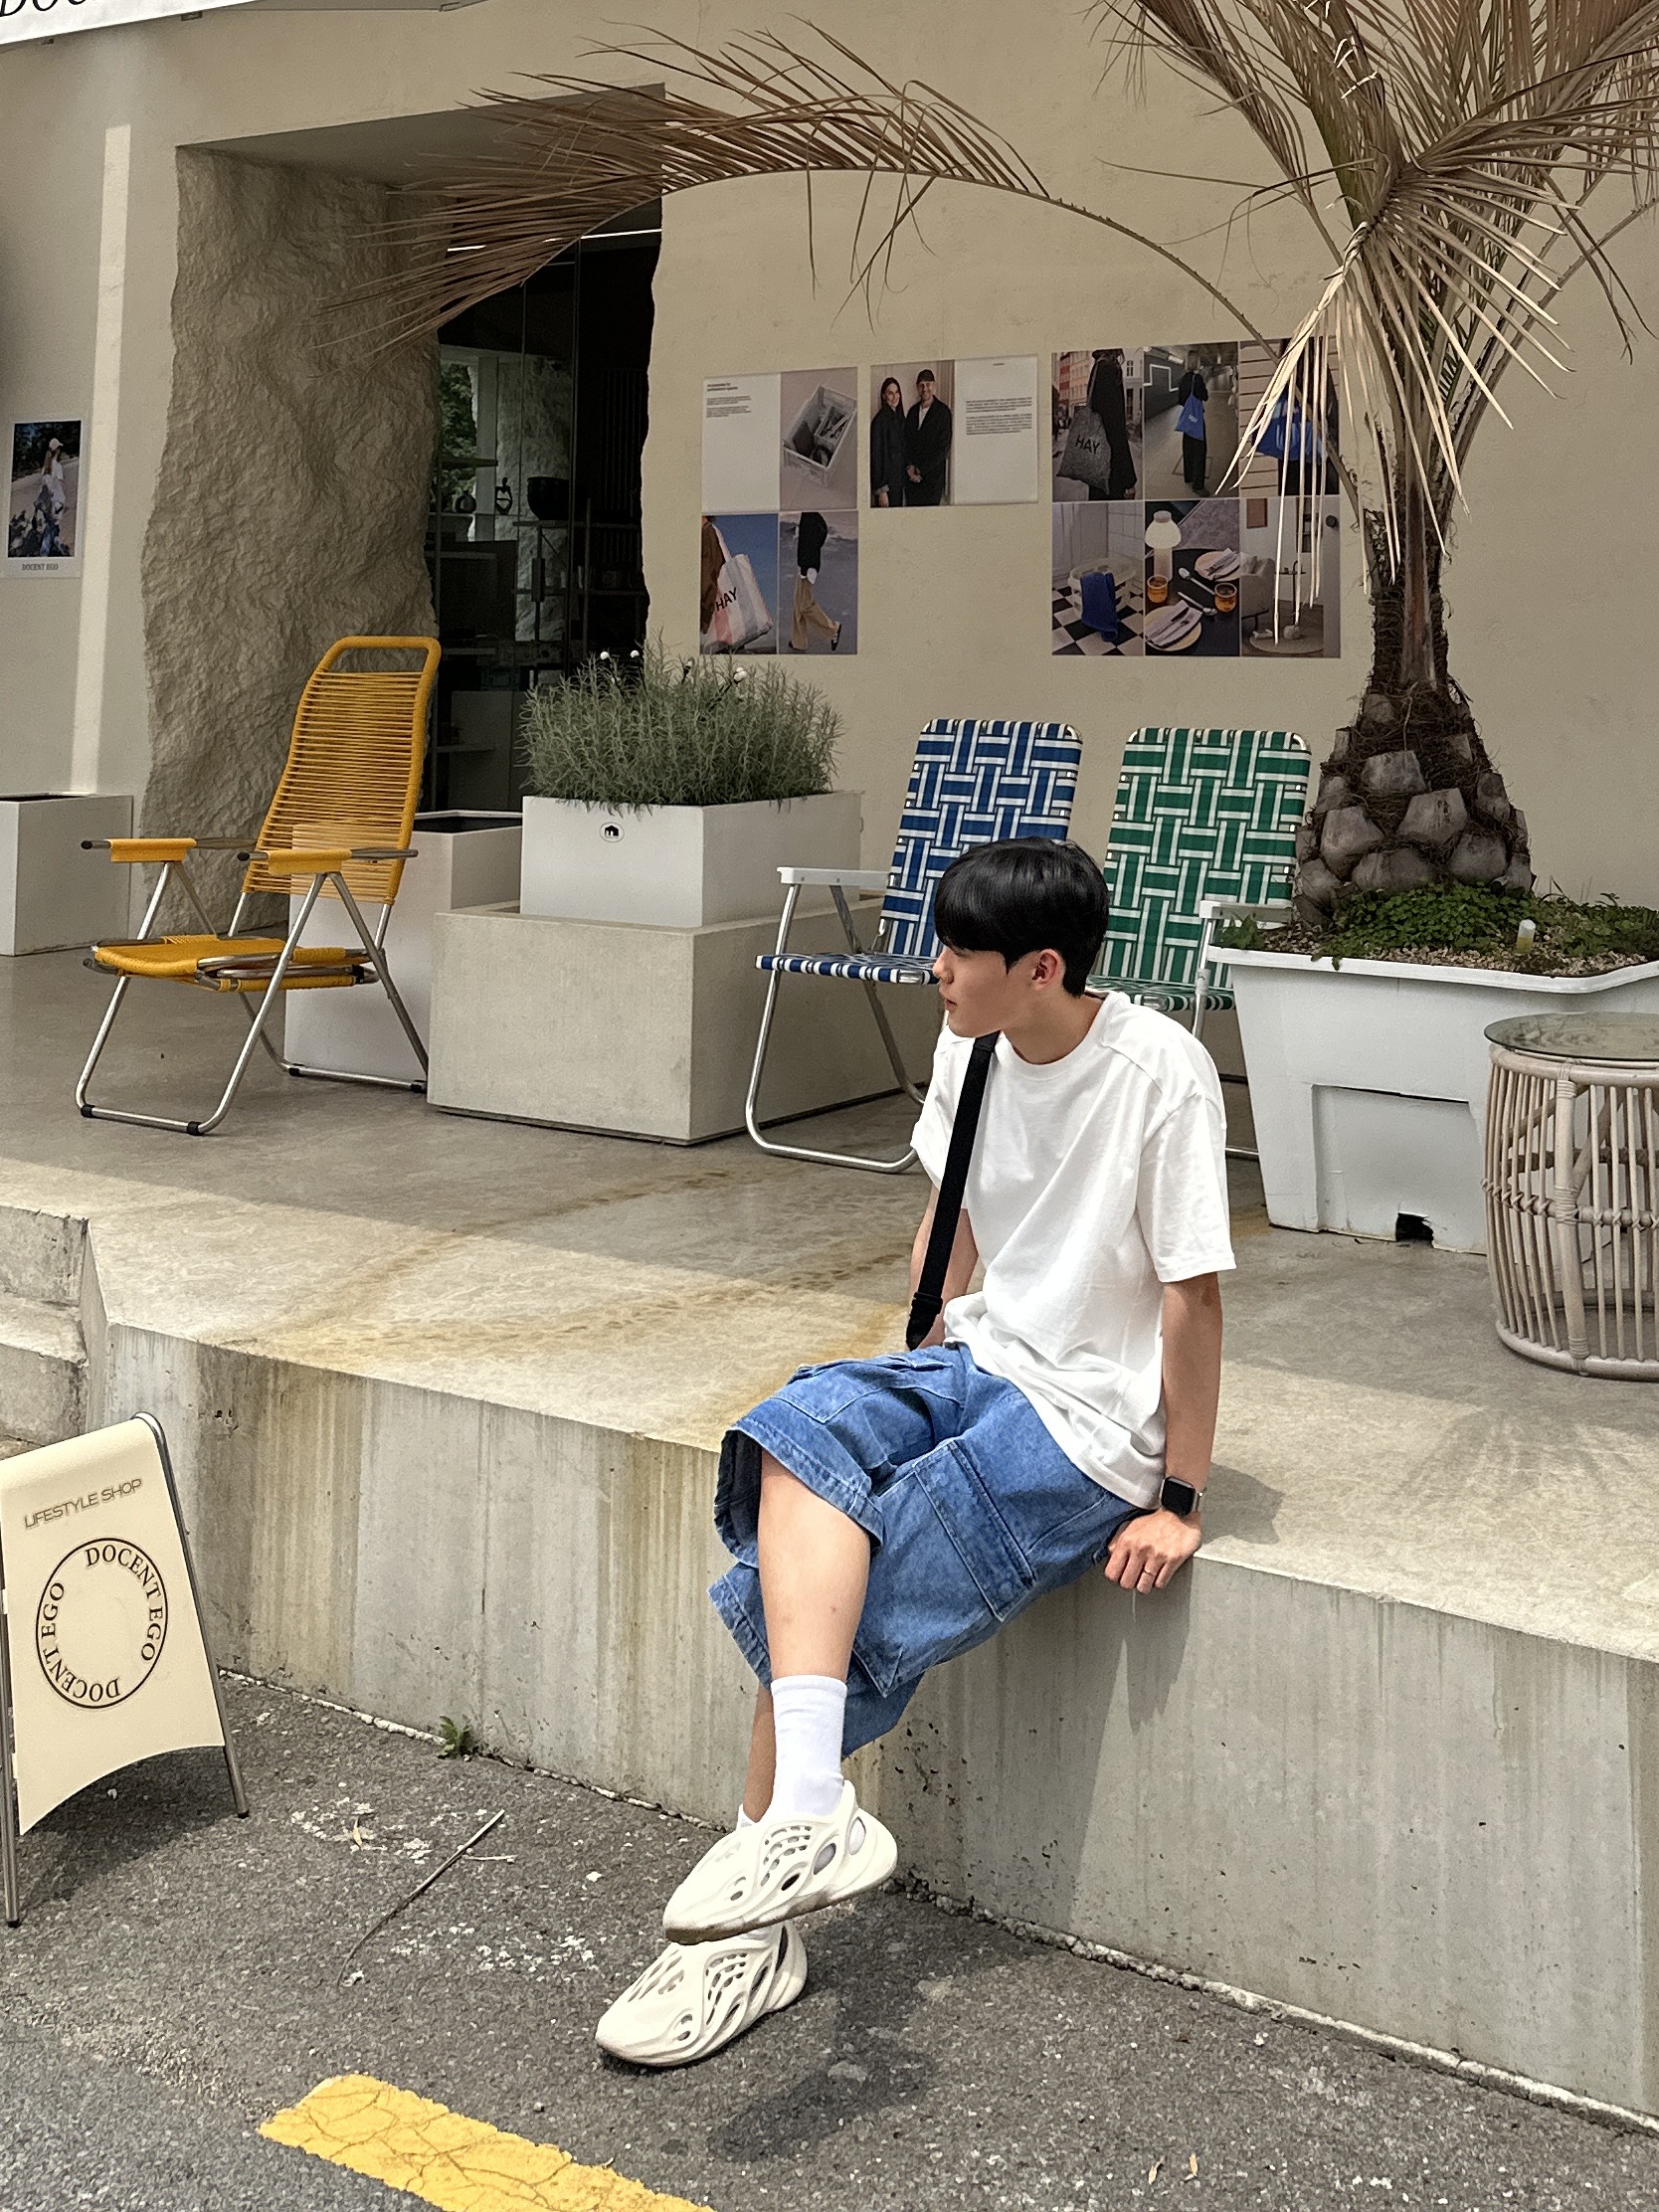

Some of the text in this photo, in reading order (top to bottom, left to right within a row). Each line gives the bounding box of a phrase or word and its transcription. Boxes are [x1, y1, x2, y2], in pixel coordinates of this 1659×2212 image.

[1074, 434, 1101, 455] HAY
[715, 587, 737, 611] HAY
[24, 1478, 142, 1528] LIFESTYLE SHOP
[85, 1544, 164, 1661] DOCENT EGO
[41, 1582, 121, 1702] DOCENT EGO
